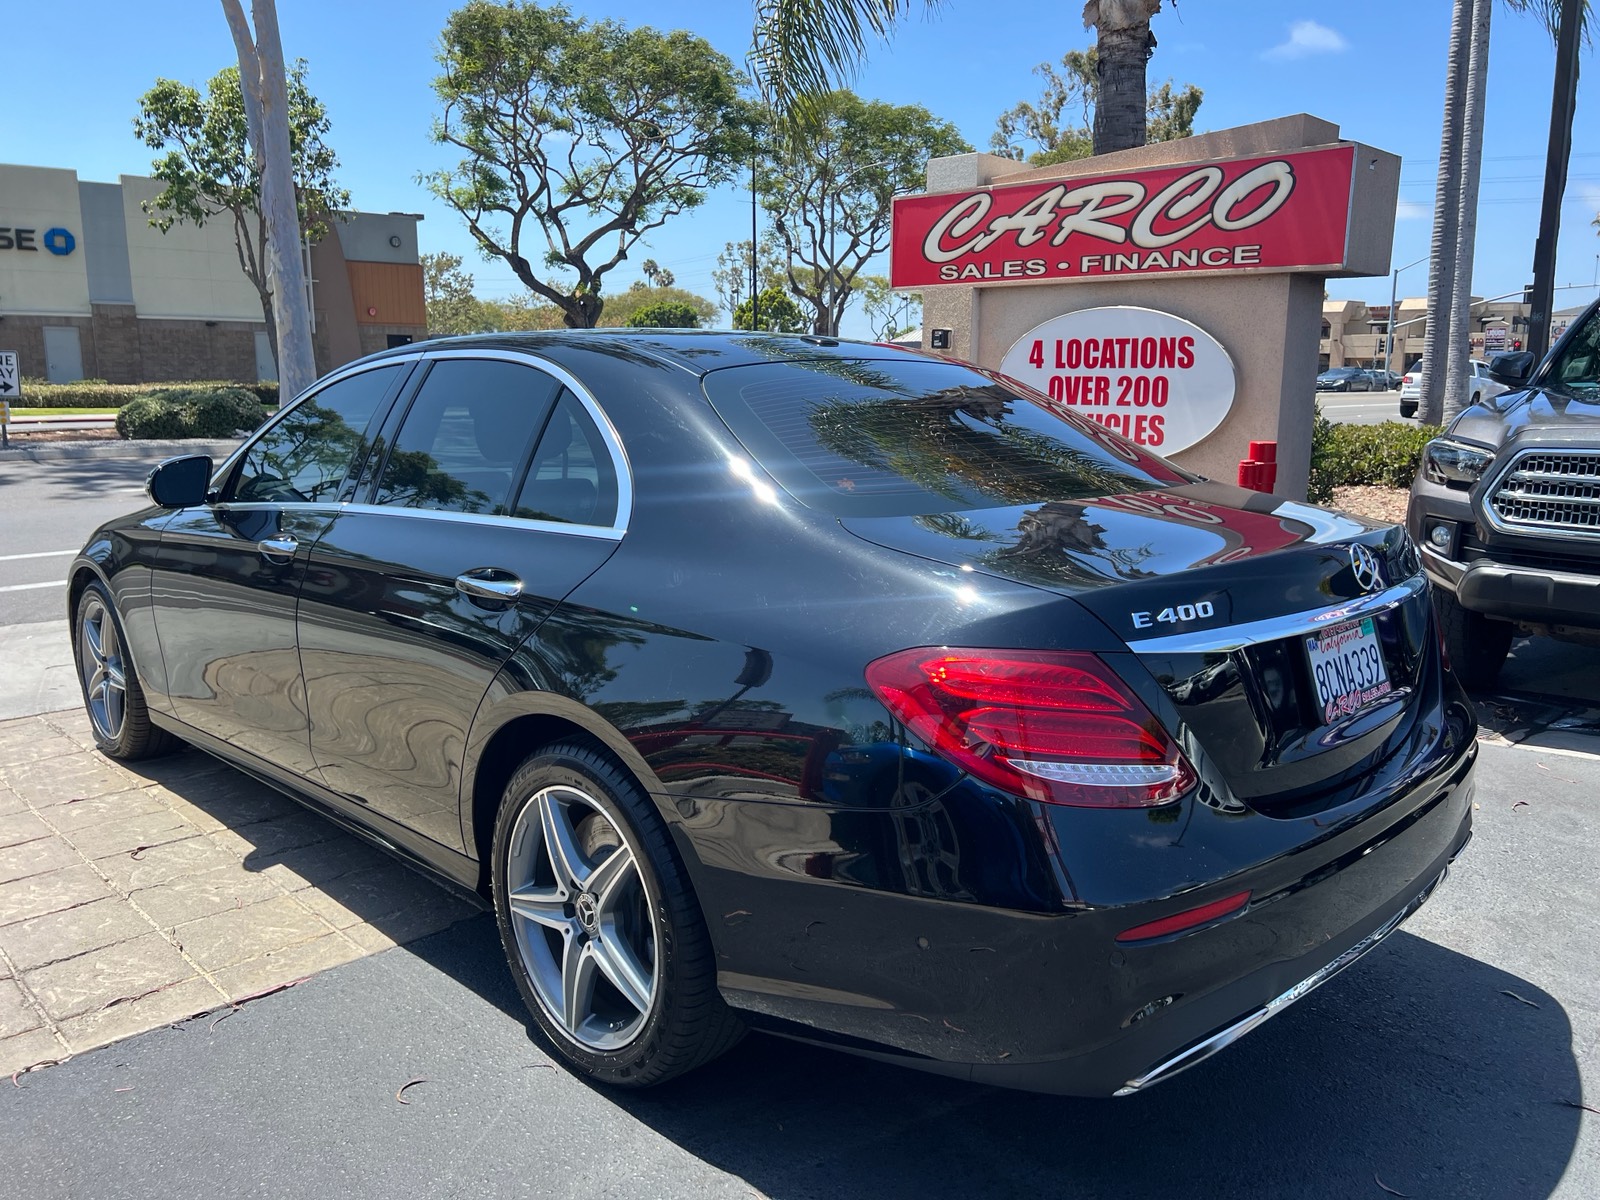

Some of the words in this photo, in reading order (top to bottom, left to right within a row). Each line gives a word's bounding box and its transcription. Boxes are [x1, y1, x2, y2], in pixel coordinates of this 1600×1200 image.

[922, 160, 1296, 263] CARCO
[939, 258, 1047, 281] SALES
[1080, 245, 1262, 273] FINANCE
[1029, 340, 1044, 368] 4
[1055, 336, 1195, 369] LOCATIONS
[1049, 375, 1110, 406] OVER
[1116, 376, 1169, 408] 200
[1131, 611, 1153, 629] E
[1156, 601, 1214, 624] 400
[1315, 643, 1380, 704] 8CNA339
